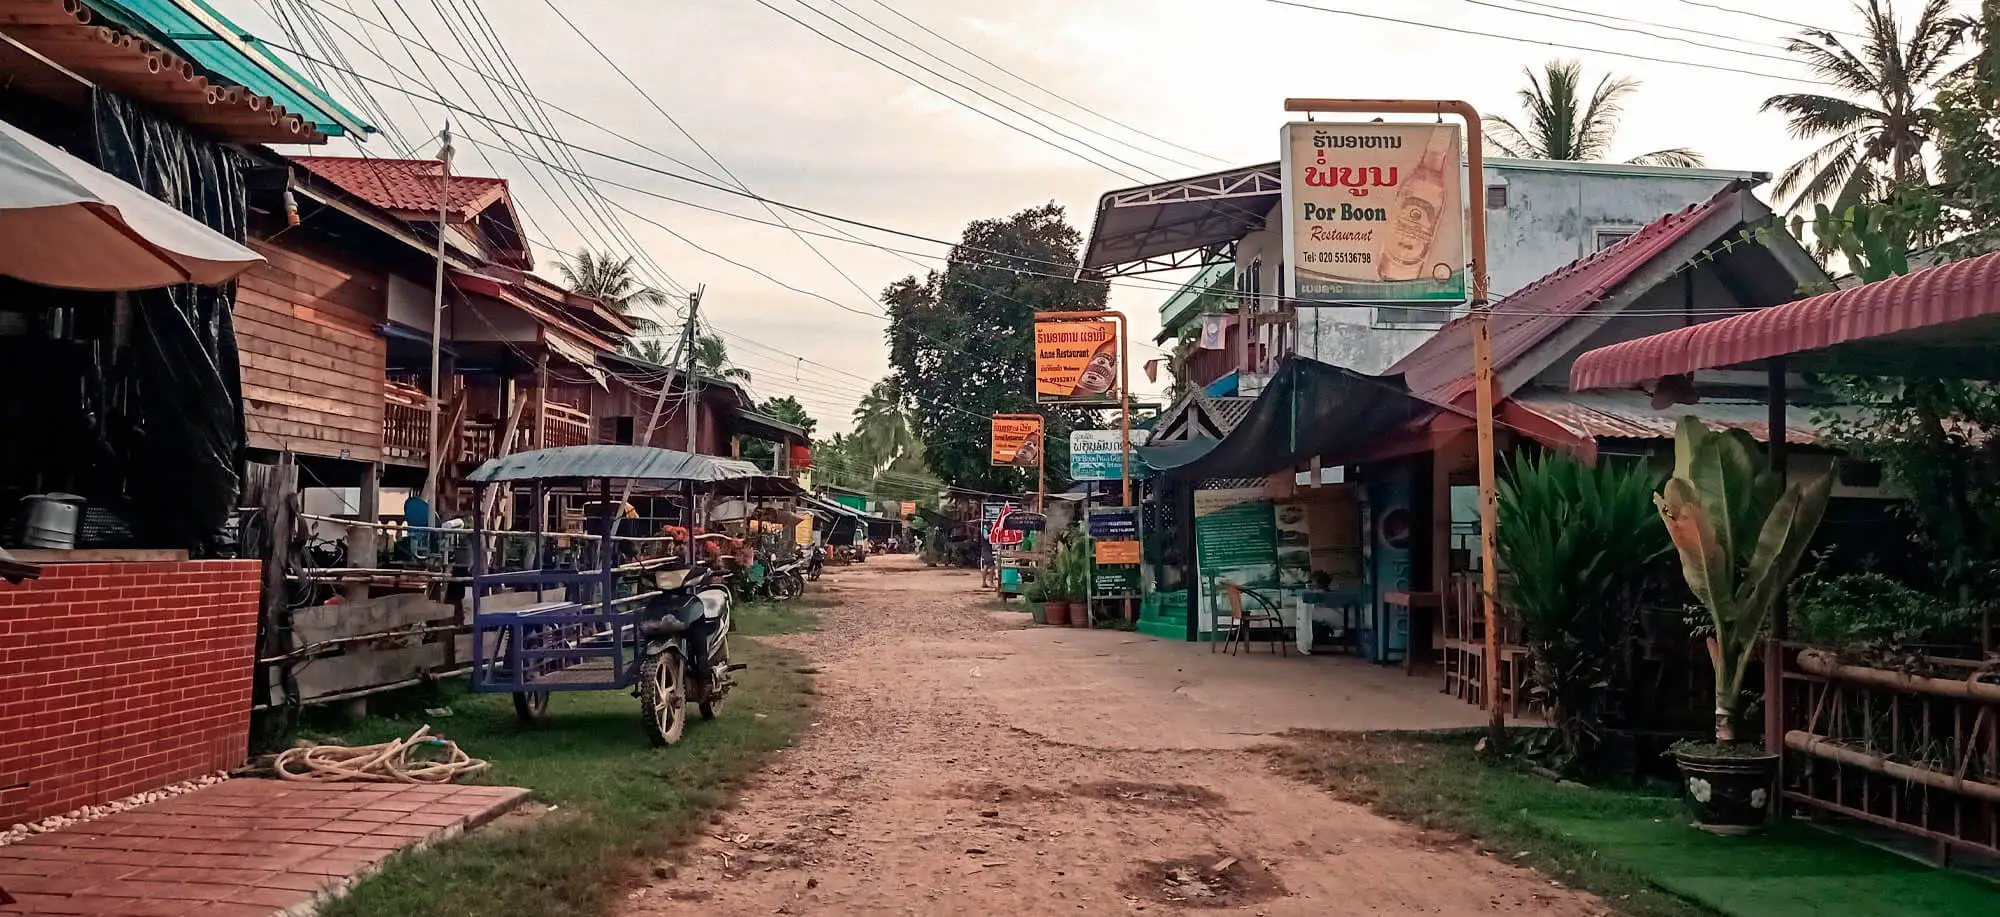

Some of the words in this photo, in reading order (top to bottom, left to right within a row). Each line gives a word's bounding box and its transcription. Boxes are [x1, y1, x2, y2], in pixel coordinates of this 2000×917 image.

[1303, 202, 1336, 221] Por
[1340, 203, 1387, 221] Boon
[1310, 225, 1373, 242] Restaurant
[1303, 251, 1317, 263] Tel:
[1319, 251, 1333, 263] 020
[1334, 252, 1371, 264] 55136798
[1039, 349, 1055, 359] Anne
[1056, 348, 1089, 358] Restaurant
